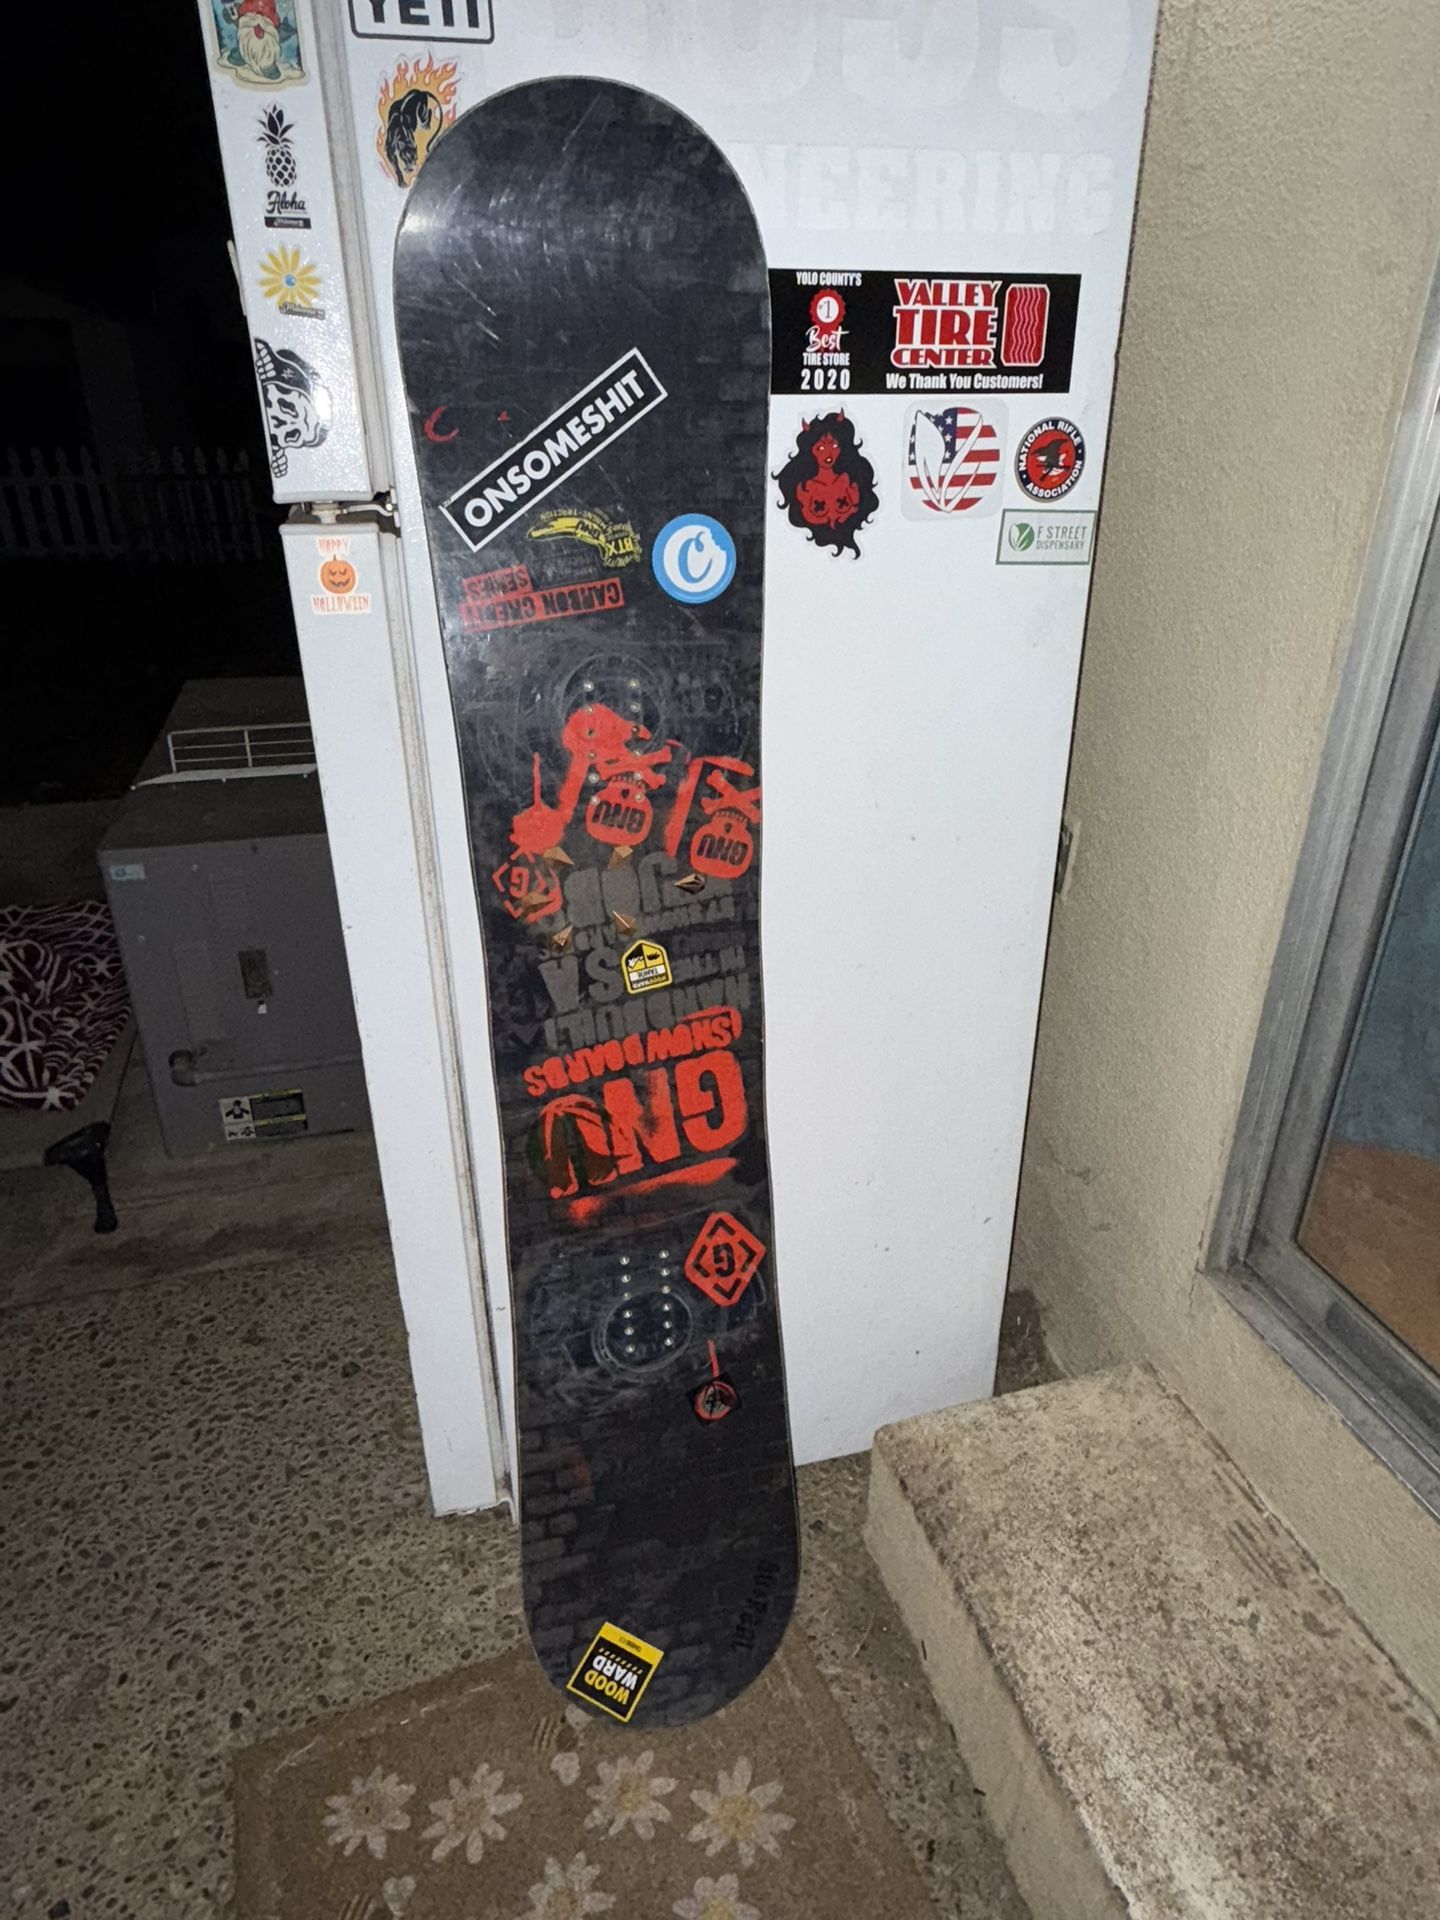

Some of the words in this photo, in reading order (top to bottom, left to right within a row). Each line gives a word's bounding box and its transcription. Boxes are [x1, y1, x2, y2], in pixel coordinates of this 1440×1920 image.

[368, 0, 479, 28] YETI
[266, 191, 306, 214] Aloha
[796, 272, 818, 286] YOLO
[820, 272, 862, 287] COUNTY'S
[894, 278, 1003, 306] VALLEY
[805, 325, 849, 352] Best
[893, 306, 998, 347] TIRE
[803, 353, 821, 366] TIRE
[822, 353, 850, 366] STORE
[890, 347, 997, 369] CENTER
[801, 368, 850, 390] 2020
[886, 373, 907, 389] We
[909, 373, 947, 389] Thank
[949, 373, 971, 389] You
[973, 374, 1044, 389] Customers!
[464, 369, 645, 527] ONSOMESHIT
[1018, 421, 1055, 472] NATIONAL
[1056, 421, 1082, 446] RIFLE
[1026, 460, 1083, 498] ASSOCIATION
[318, 539, 348, 553] HAPPY
[608, 535, 634, 557] BTX
[1036, 540, 1085, 550] DISPENSARY
[1037, 526, 1045, 539] F
[1046, 526, 1087, 540] STREET
[313, 595, 369, 612] HALLOWEEN
[541, 582, 622, 616] CARBON
[592, 800, 646, 834] GNU
[697, 834, 748, 866] GNU
[523, 1017, 733, 1097] SNOWBOARDS
[592, 1655, 638, 1690] WARD
[584, 1669, 630, 1704] WOOD
